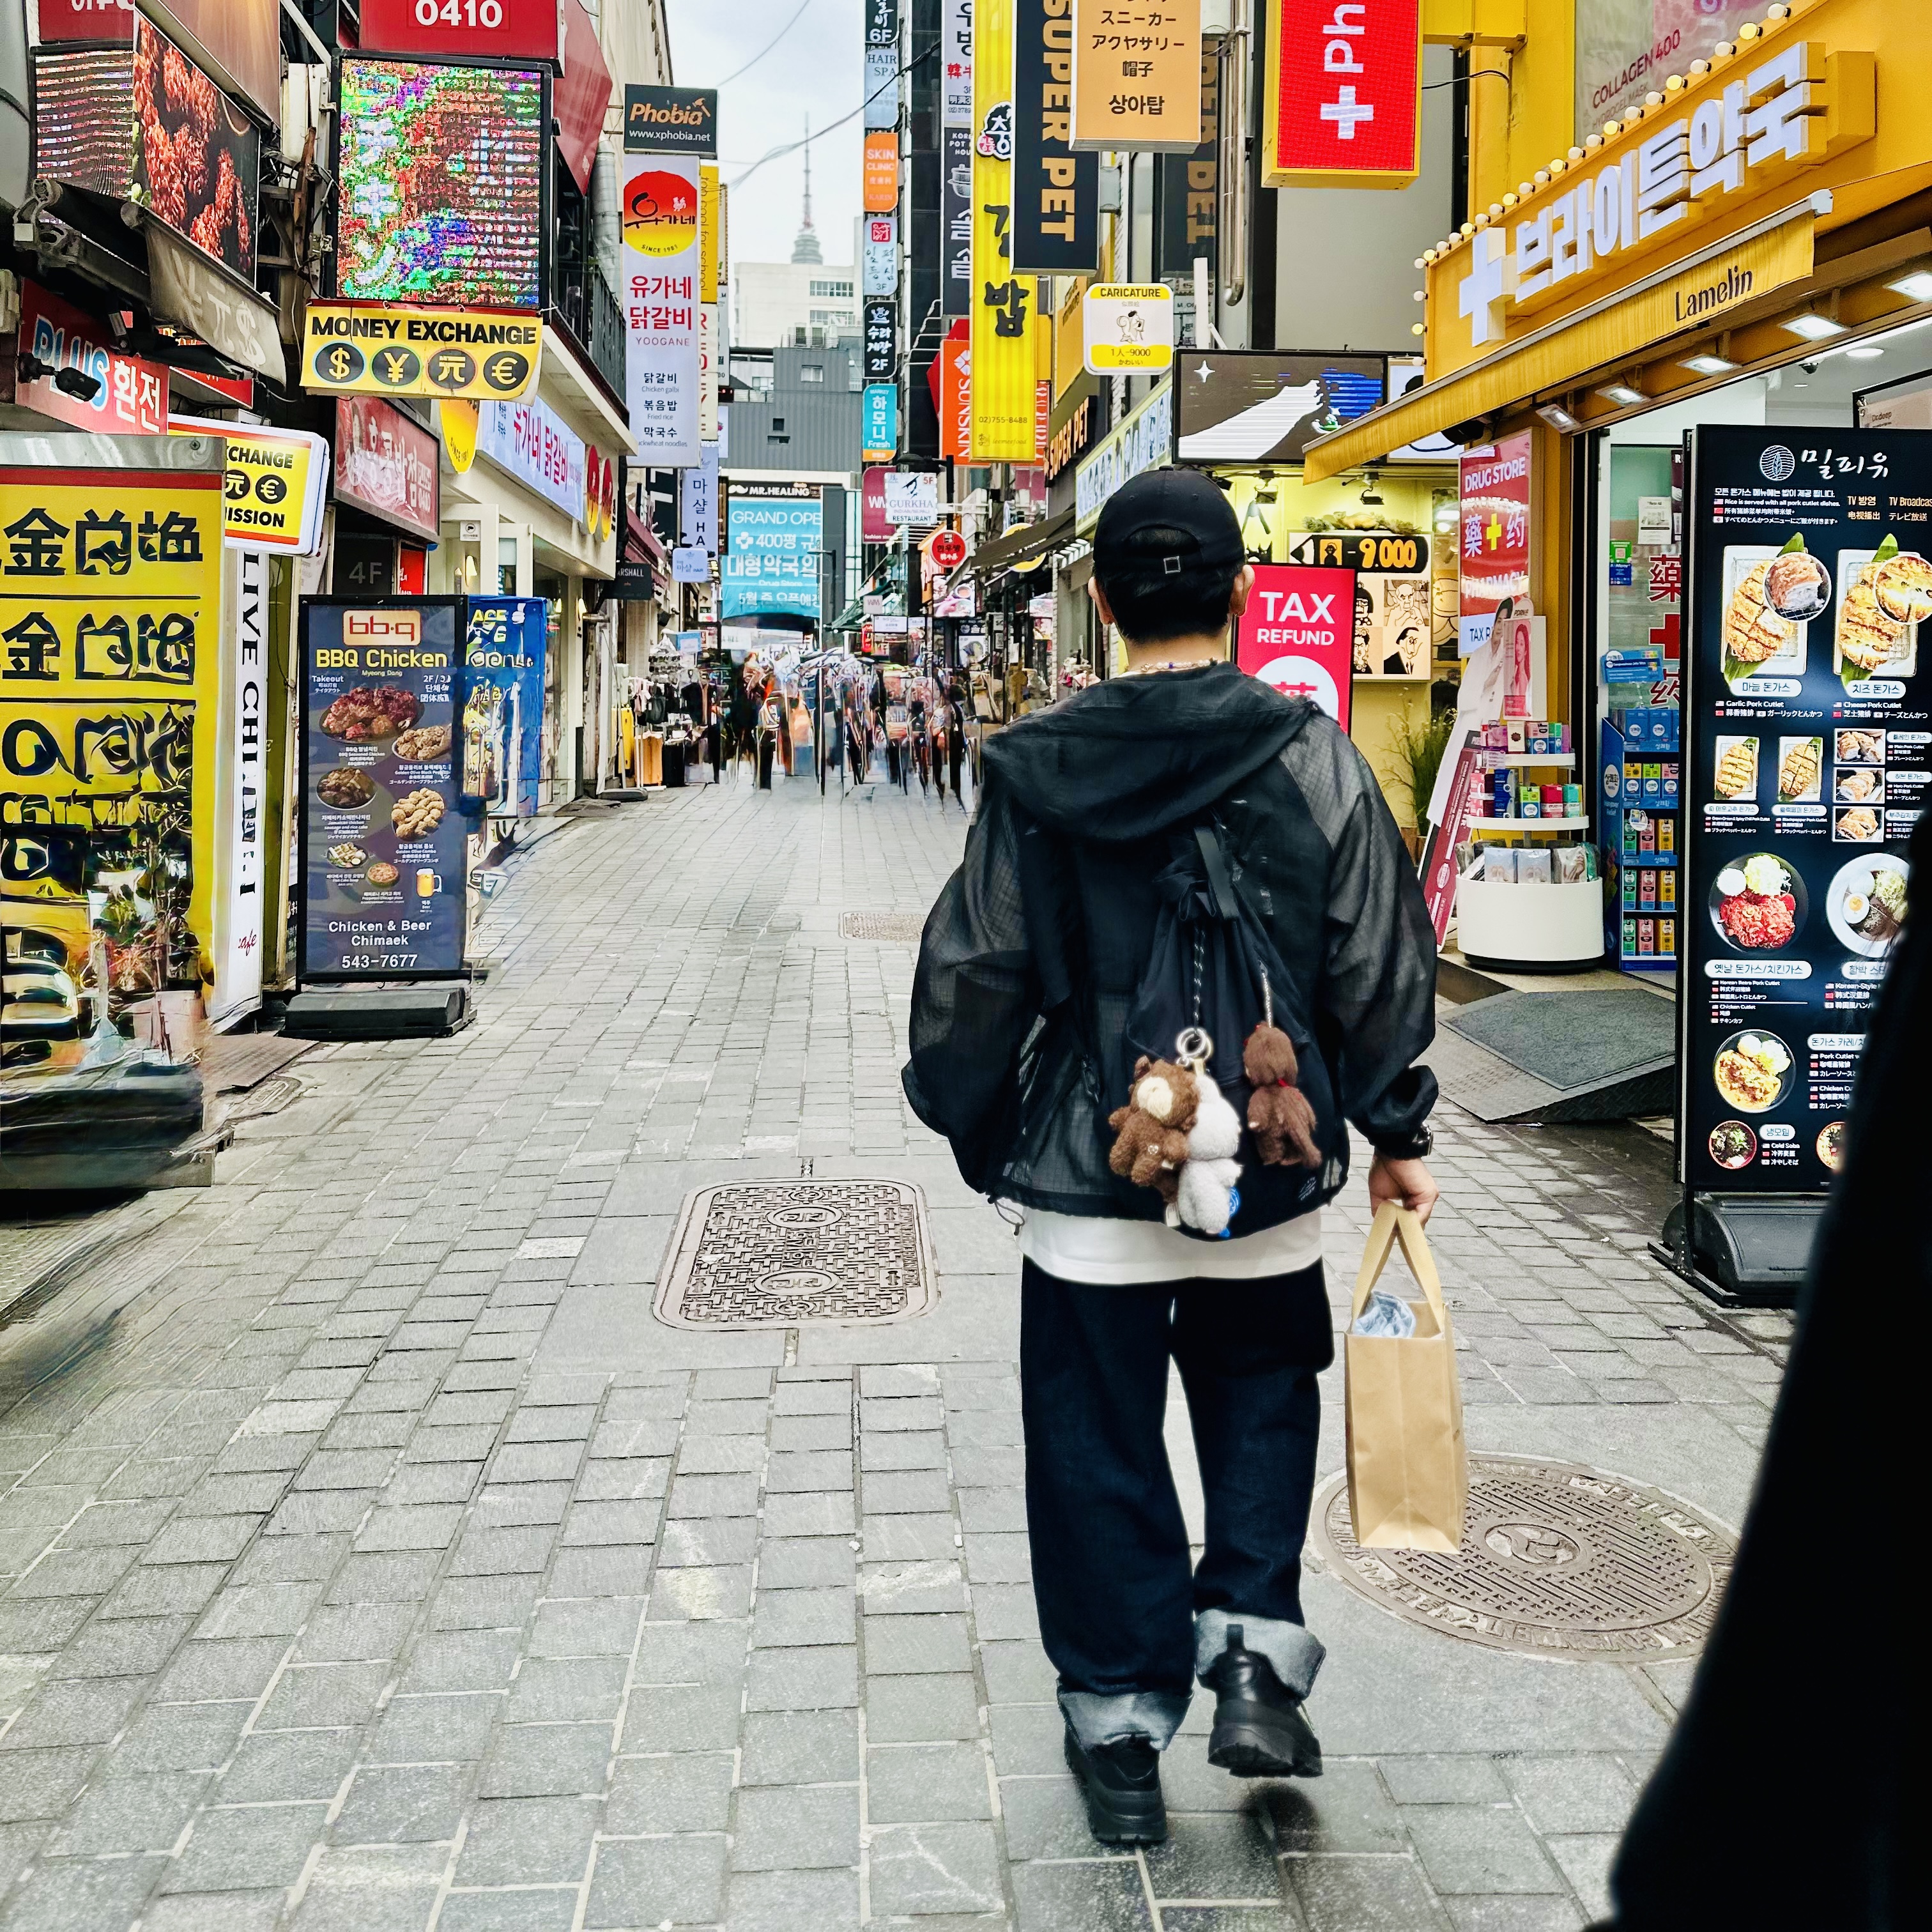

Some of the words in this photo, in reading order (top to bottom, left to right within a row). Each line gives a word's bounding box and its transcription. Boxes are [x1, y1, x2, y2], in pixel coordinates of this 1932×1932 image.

[415, 0, 503, 28] 0410
[1101, 10, 1176, 26] スニーカー
[870, 28, 892, 42] 6F
[867, 54, 897, 64] HAIR
[874, 67, 895, 76] SPA
[1123, 61, 1153, 77] 帽子
[1593, 49, 1653, 109] COLLAGEN
[1655, 29, 1681, 61] 400
[1108, 95, 1165, 115] 상아탑
[629, 130, 711, 142] www.xphobia.net
[867, 148, 894, 160] SKIN
[866, 162, 894, 171] CLINIC
[1515, 42, 1812, 305] 브라이트약국
[1040, 157, 1076, 243] PET
[624, 192, 696, 229] 유가네
[701, 201, 709, 226] cool
[701, 231, 709, 247] for
[641, 244, 661, 254] SINCE
[701, 250, 709, 291] school
[630, 275, 692, 300] 유가네
[1100, 288, 1161, 298] CARICATURE
[1675, 265, 1753, 322] Lamelin
[630, 307, 692, 330] 닭갈비
[311, 316, 399, 339] MONEY
[408, 321, 537, 345] EXCHANGE
[636, 337, 690, 346] YOOGANE
[871, 358, 888, 371] 2F
[643, 372, 677, 384] 닭갈비
[113, 358, 162, 433] 환전
[643, 400, 678, 411] 볶음밥
[872, 395, 887, 440] 하모니
[978, 416, 1028, 424] 02)755-8488
[1073, 396, 1089, 454] PET
[643, 426, 678, 438] 막국수
[544, 425, 569, 493] 닭갈비
[1465, 467, 1491, 493] DRUG
[1492, 456, 1526, 485] STORE
[749, 486, 810, 496] MR.HEALING
[889, 500, 933, 509] GURKHA
[1848, 496, 1857, 505] TV
[1859, 496, 1876, 506] 방영
[1889, 497, 1897, 506] TV
[226, 506, 285, 529] ISSION
[731, 510, 788, 525] GRAND
[790, 512, 821, 525] OPE
[1889, 512, 1928, 521] テレビ放送
[756, 533, 797, 549] 400평
[348, 562, 382, 584] 4F
[1465, 571, 1525, 599] PHARMACY
[242, 553, 261, 666] LIVE
[1259, 591, 1336, 624] TAX
[1257, 628, 1335, 646] REFUND
[1470, 627, 1484, 642] TAX
[316, 648, 358, 668] BBQ
[365, 648, 447, 668] Chicken
[1742, 682, 1761, 692] 마늘
[1763, 682, 1791, 692] 돈가스
[1852, 684, 1871, 694] 치즈
[1873, 684, 1901, 694] 돈가스
[328, 920, 383, 932] Chicken
[401, 920, 432, 931] Beer
[351, 933, 409, 946] Chimaek
[342, 954, 418, 969] 543-7677
[1714, 963, 1733, 974] 옛날
[1812, 1038, 1836, 1046] 돈가스
